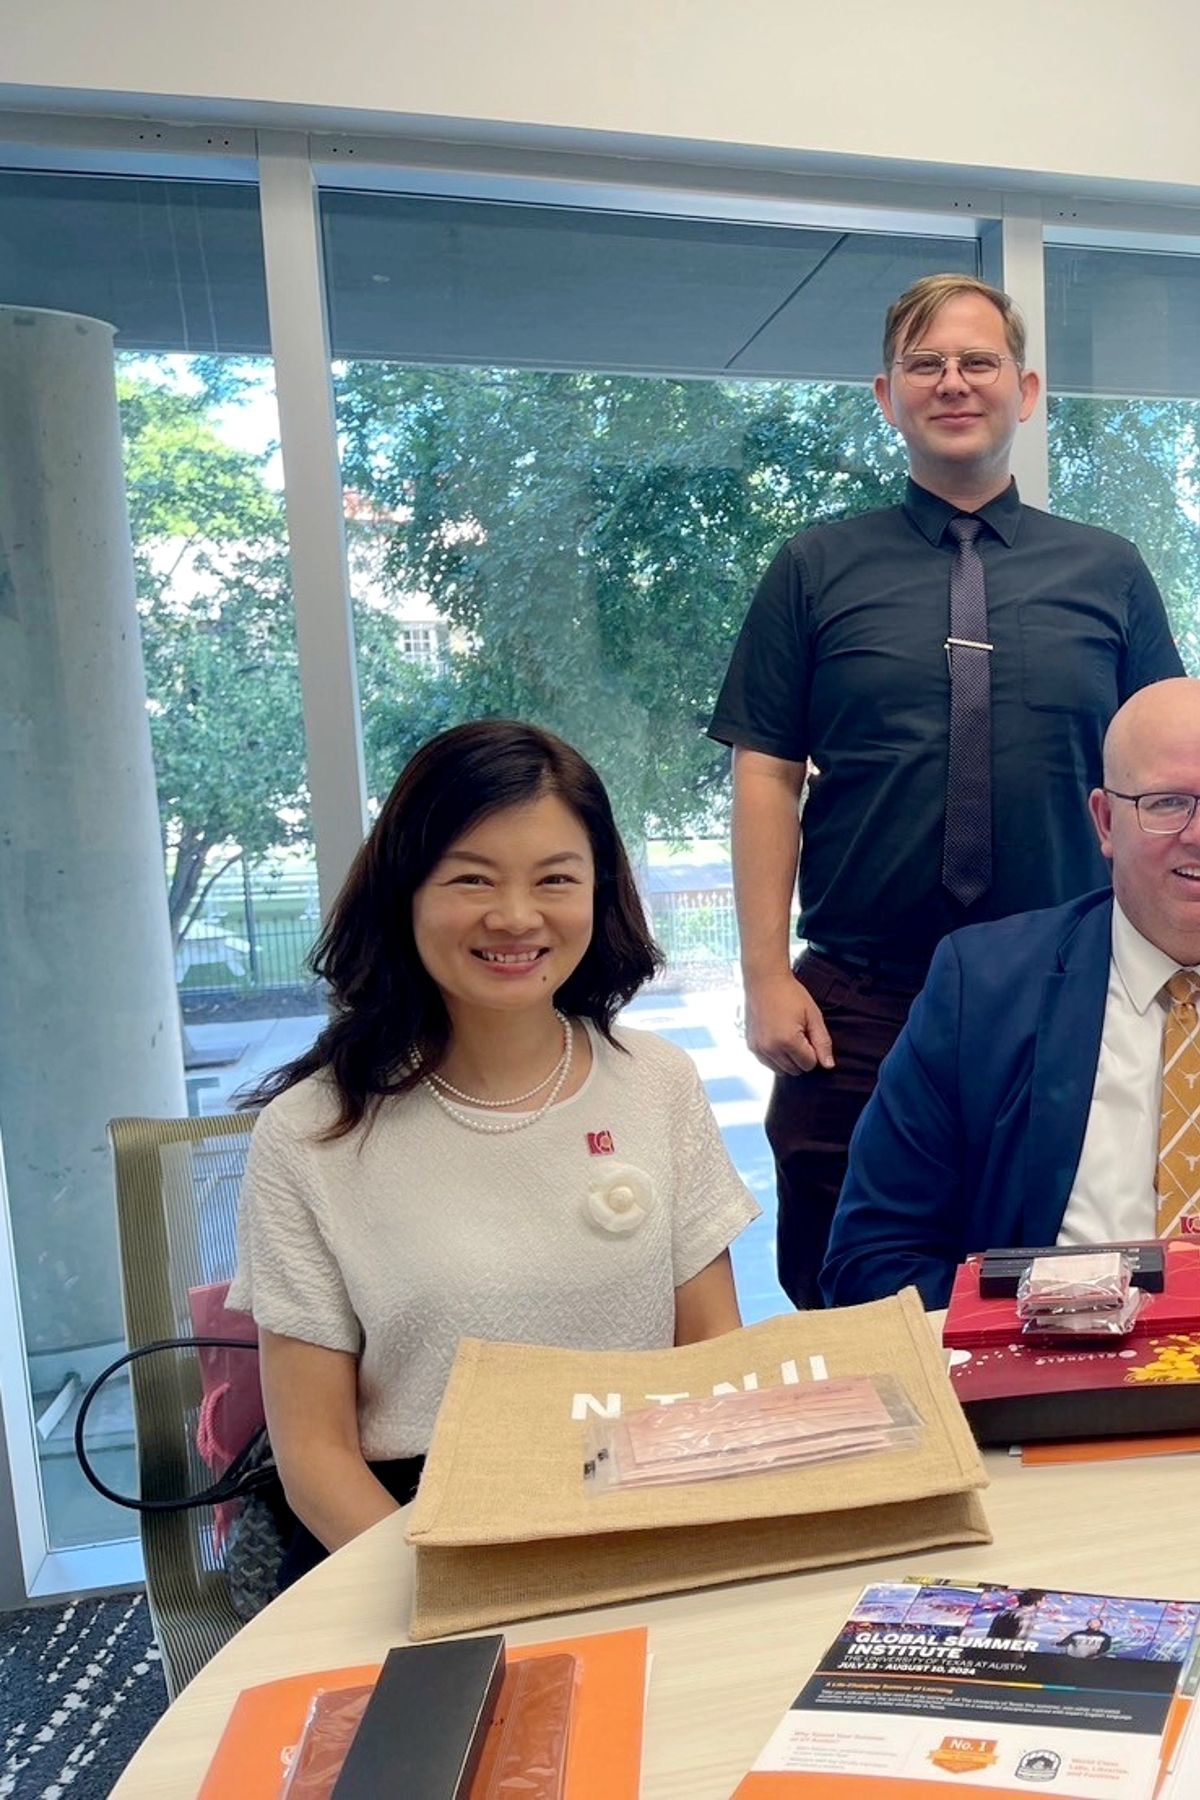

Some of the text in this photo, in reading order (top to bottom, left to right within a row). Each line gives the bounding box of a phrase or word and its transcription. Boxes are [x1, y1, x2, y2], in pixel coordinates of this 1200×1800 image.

[855, 1632, 1039, 1652] GLOBAL SUMMER
[847, 1643, 963, 1659] INSTITUTE
[837, 1661, 863, 1670] JULY
[885, 1663, 931, 1672] AUGUST
[947, 1666, 976, 1675] 2024
[863, 1655, 923, 1665] UNIVERSITY
[942, 1659, 973, 1668] TEXAS
[988, 1663, 1027, 1671] AUSTIN
[950, 1739, 987, 1752] No. 1
